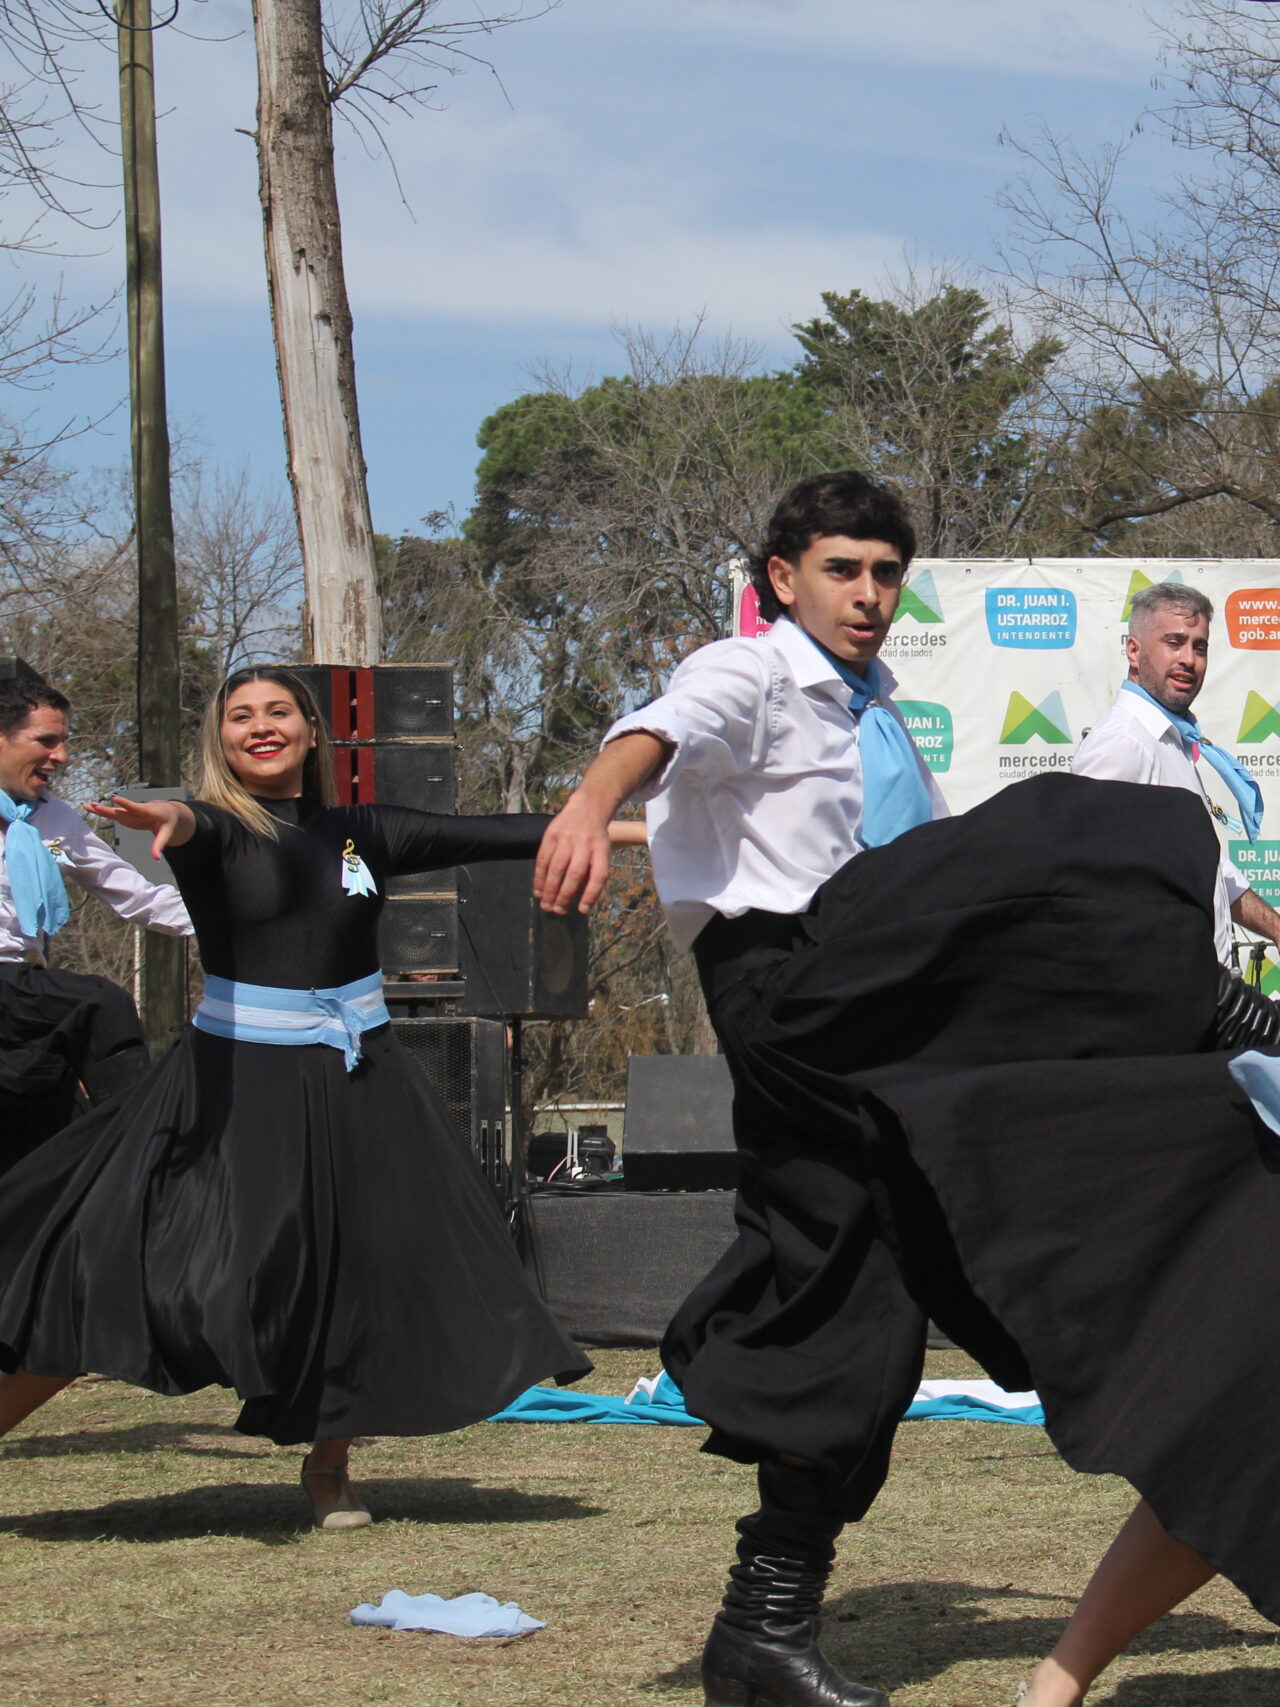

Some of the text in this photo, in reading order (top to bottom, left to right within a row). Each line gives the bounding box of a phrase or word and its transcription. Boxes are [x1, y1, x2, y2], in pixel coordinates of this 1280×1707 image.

[997, 594, 1070, 609] DR. JUAN I.
[1238, 600, 1280, 610] www.
[997, 613, 1068, 626] USTARROZ
[884, 631, 947, 647] ercedes
[997, 631, 1071, 640] INTENDENTE
[900, 649, 910, 657] de
[911, 648, 933, 657] todos
[904, 717, 945, 728] UAN I.
[1265, 768, 1275, 777] de
[1238, 849, 1261, 862] DR.
